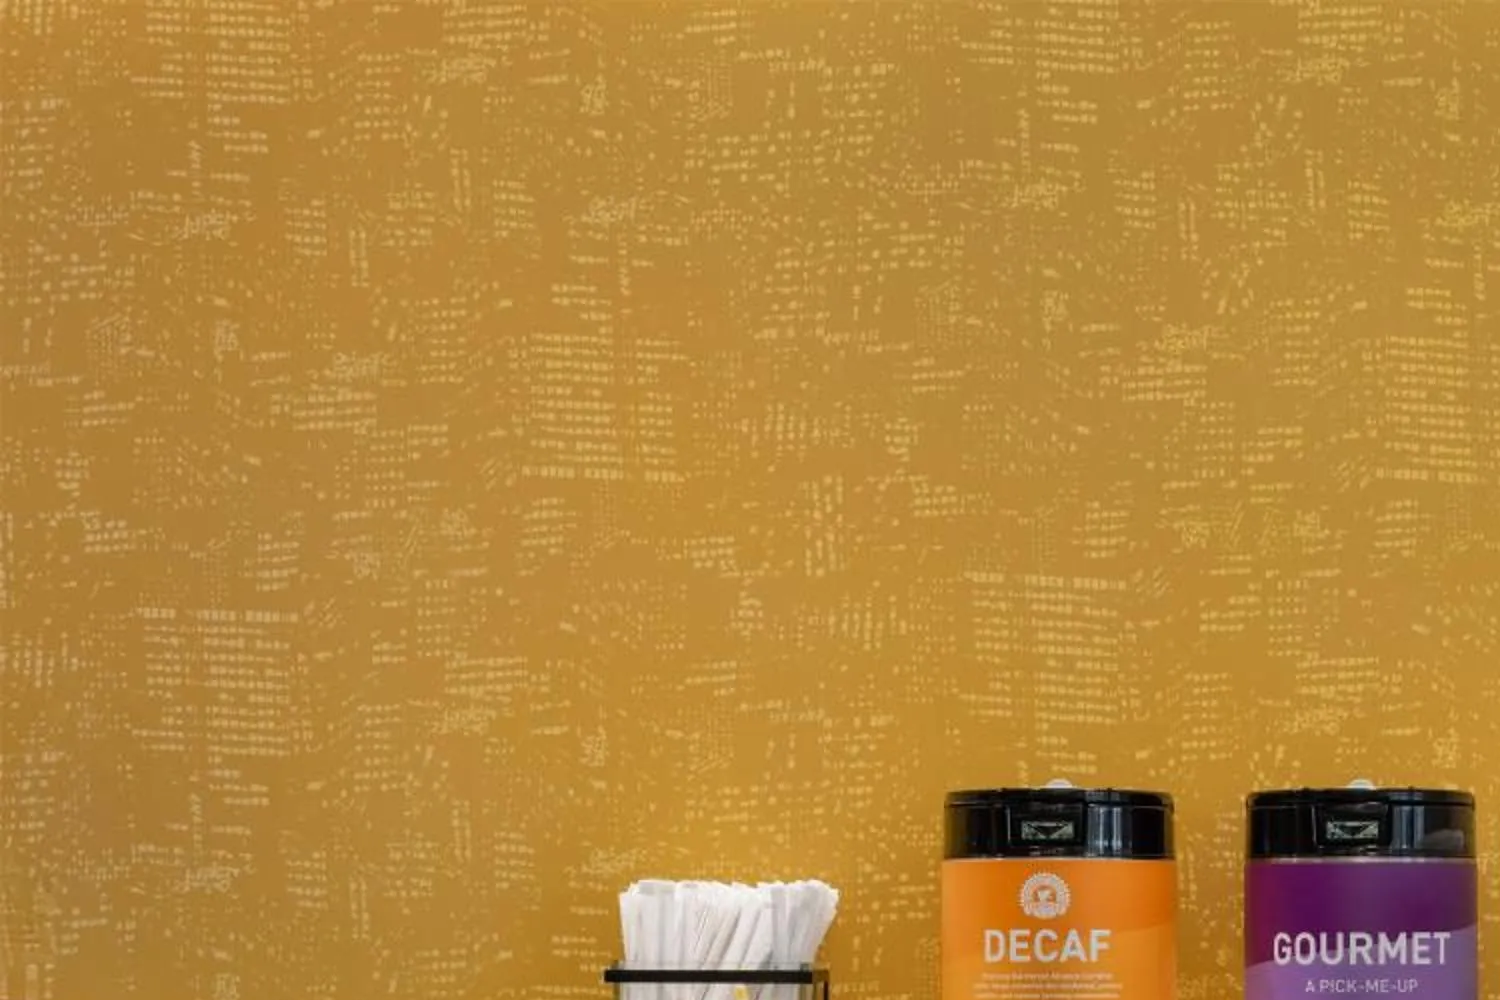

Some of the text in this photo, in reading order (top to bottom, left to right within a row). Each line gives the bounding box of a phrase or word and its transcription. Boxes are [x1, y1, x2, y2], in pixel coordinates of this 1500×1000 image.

[983, 927, 1112, 962] DECAF
[1273, 931, 1451, 965] GOURMET
[1304, 979, 1418, 993] A PICK-ME-UP
